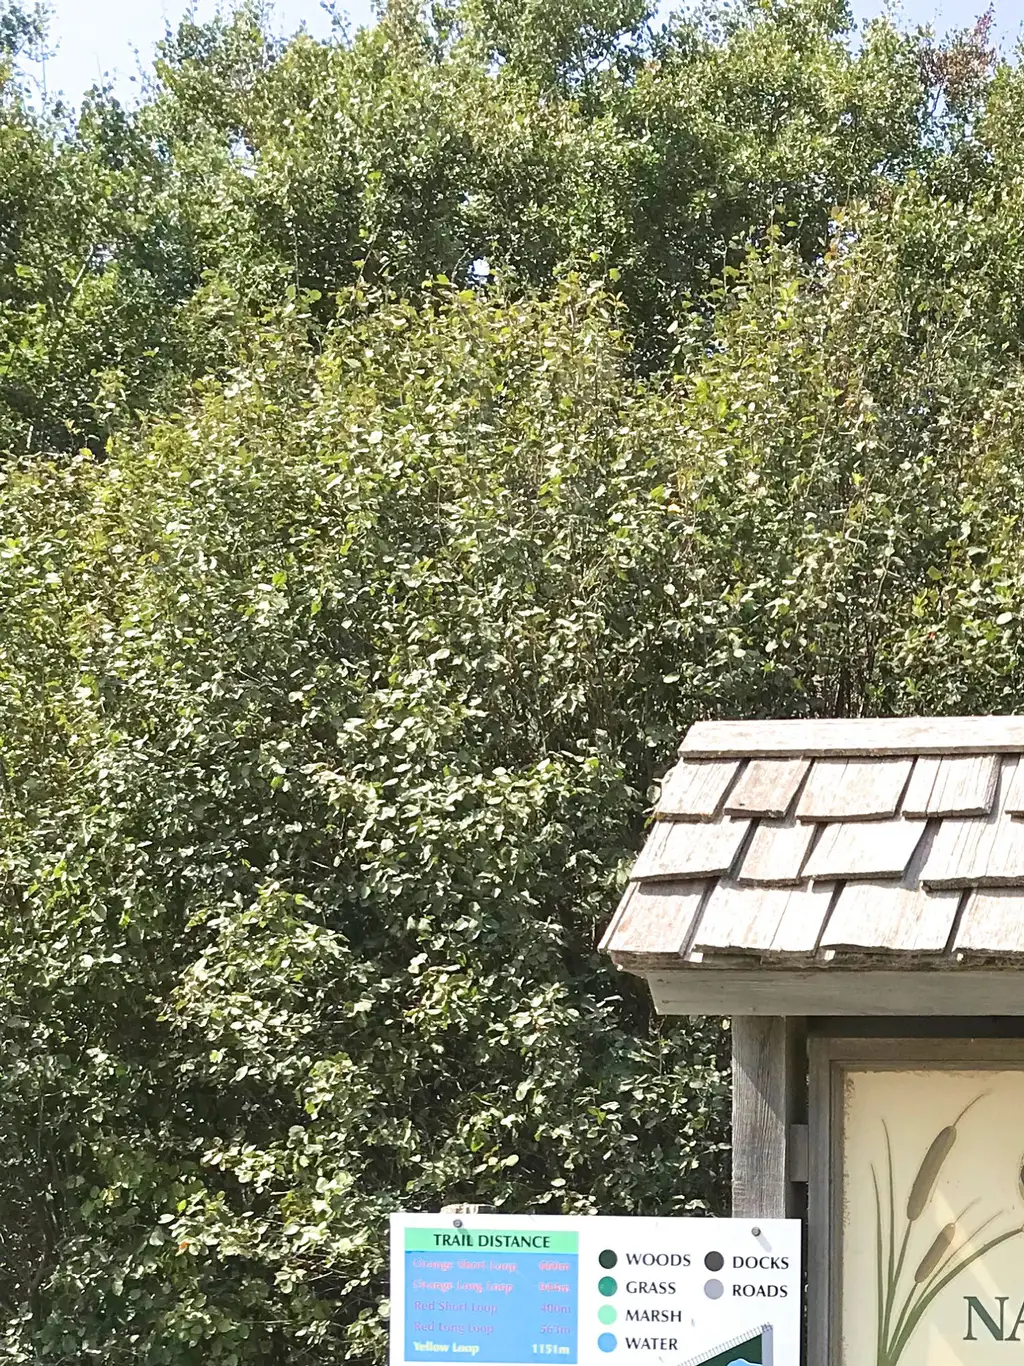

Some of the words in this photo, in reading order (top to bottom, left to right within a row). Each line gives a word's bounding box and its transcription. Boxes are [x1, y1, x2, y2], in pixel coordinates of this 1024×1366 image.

[433, 1233, 474, 1247] TRAIL
[478, 1234, 551, 1249] DISTANCE
[625, 1253, 691, 1267] WOODS
[732, 1256, 790, 1270] DOCKS
[625, 1281, 676, 1295] GRASS
[732, 1284, 789, 1298] ROADS
[414, 1300, 435, 1311] Red
[438, 1301, 468, 1312] Short
[471, 1302, 498, 1315] Loop
[625, 1309, 682, 1323] MARSH
[414, 1321, 435, 1332] Red
[438, 1322, 464, 1335] Long
[468, 1322, 494, 1335] Loop
[412, 1341, 449, 1353] Yellow
[452, 1342, 480, 1356] Loop
[532, 1344, 570, 1355] 1151m
[625, 1337, 678, 1351] WATER
